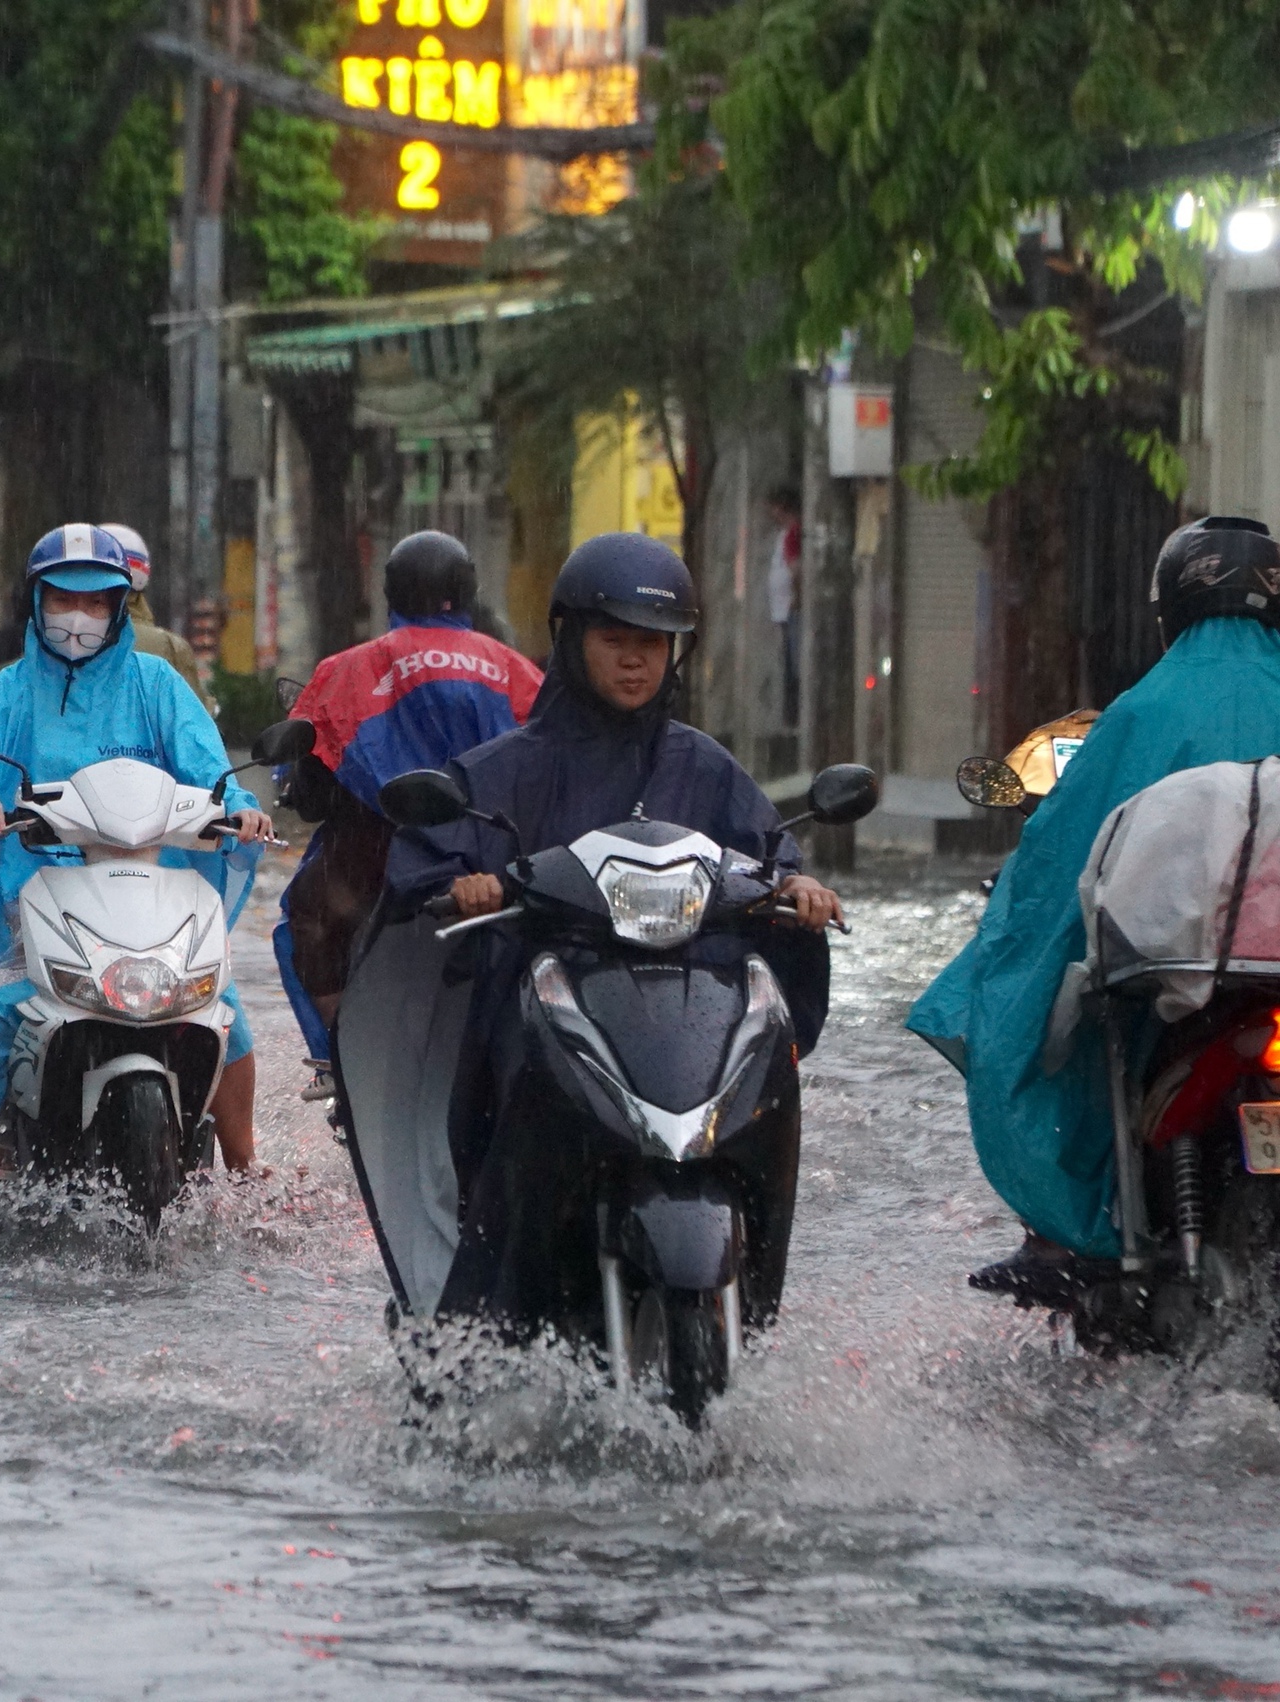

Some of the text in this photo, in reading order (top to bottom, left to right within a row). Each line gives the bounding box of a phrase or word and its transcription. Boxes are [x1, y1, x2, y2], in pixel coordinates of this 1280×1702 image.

[397, 140, 442, 209] 2
[636, 586, 676, 600] HONDA
[108, 869, 150, 878] HONDA
